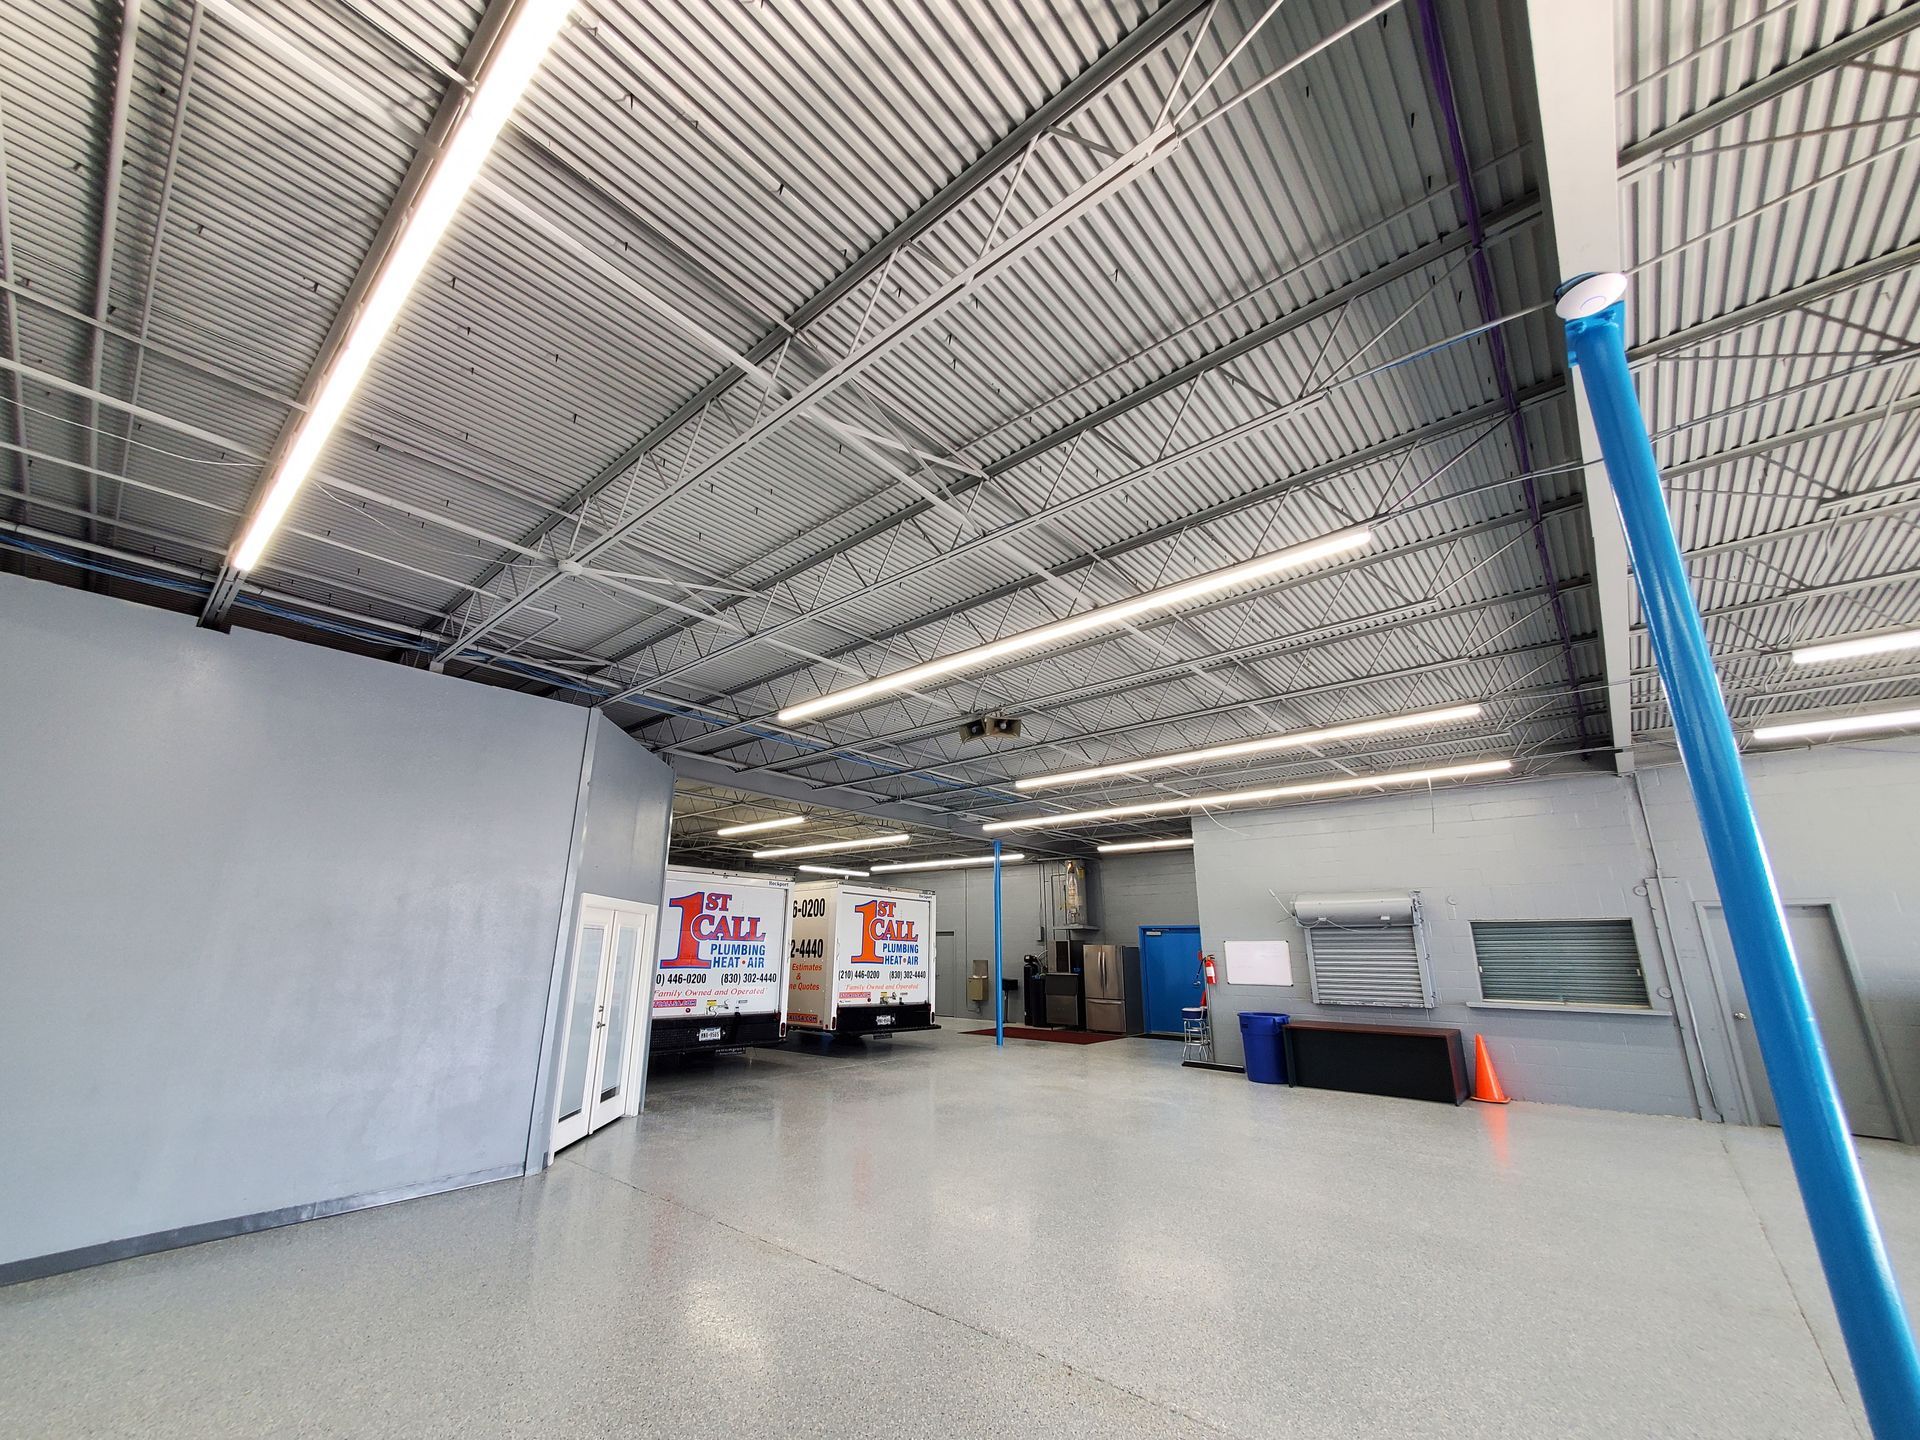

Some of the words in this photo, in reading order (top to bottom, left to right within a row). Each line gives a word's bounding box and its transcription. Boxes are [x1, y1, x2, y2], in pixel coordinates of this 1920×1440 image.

[691, 914, 766, 942] CALL
[870, 919, 919, 942] CALL
[710, 943, 766, 956] PLUMBING
[883, 943, 919, 953] PLUMBING
[713, 957, 740, 968] HEAT
[747, 957, 765, 968] AIR
[885, 955, 902, 965] HEAT
[907, 956, 919, 965] AIR
[792, 963, 822, 971] Estimates
[667, 973, 707, 984] 446-0200
[721, 973, 741, 985] (830)
[743, 972, 777, 983] 302-4440
[796, 972, 801, 981] &
[838, 970, 854, 980] (210)
[854, 970, 880, 979] 446-0200
[889, 971, 903, 981] (830)
[903, 971, 927, 979] 302-4440
[685, 989, 712, 997] Owned
[730, 987, 765, 997] Operated
[798, 983, 820, 991] Quotes
